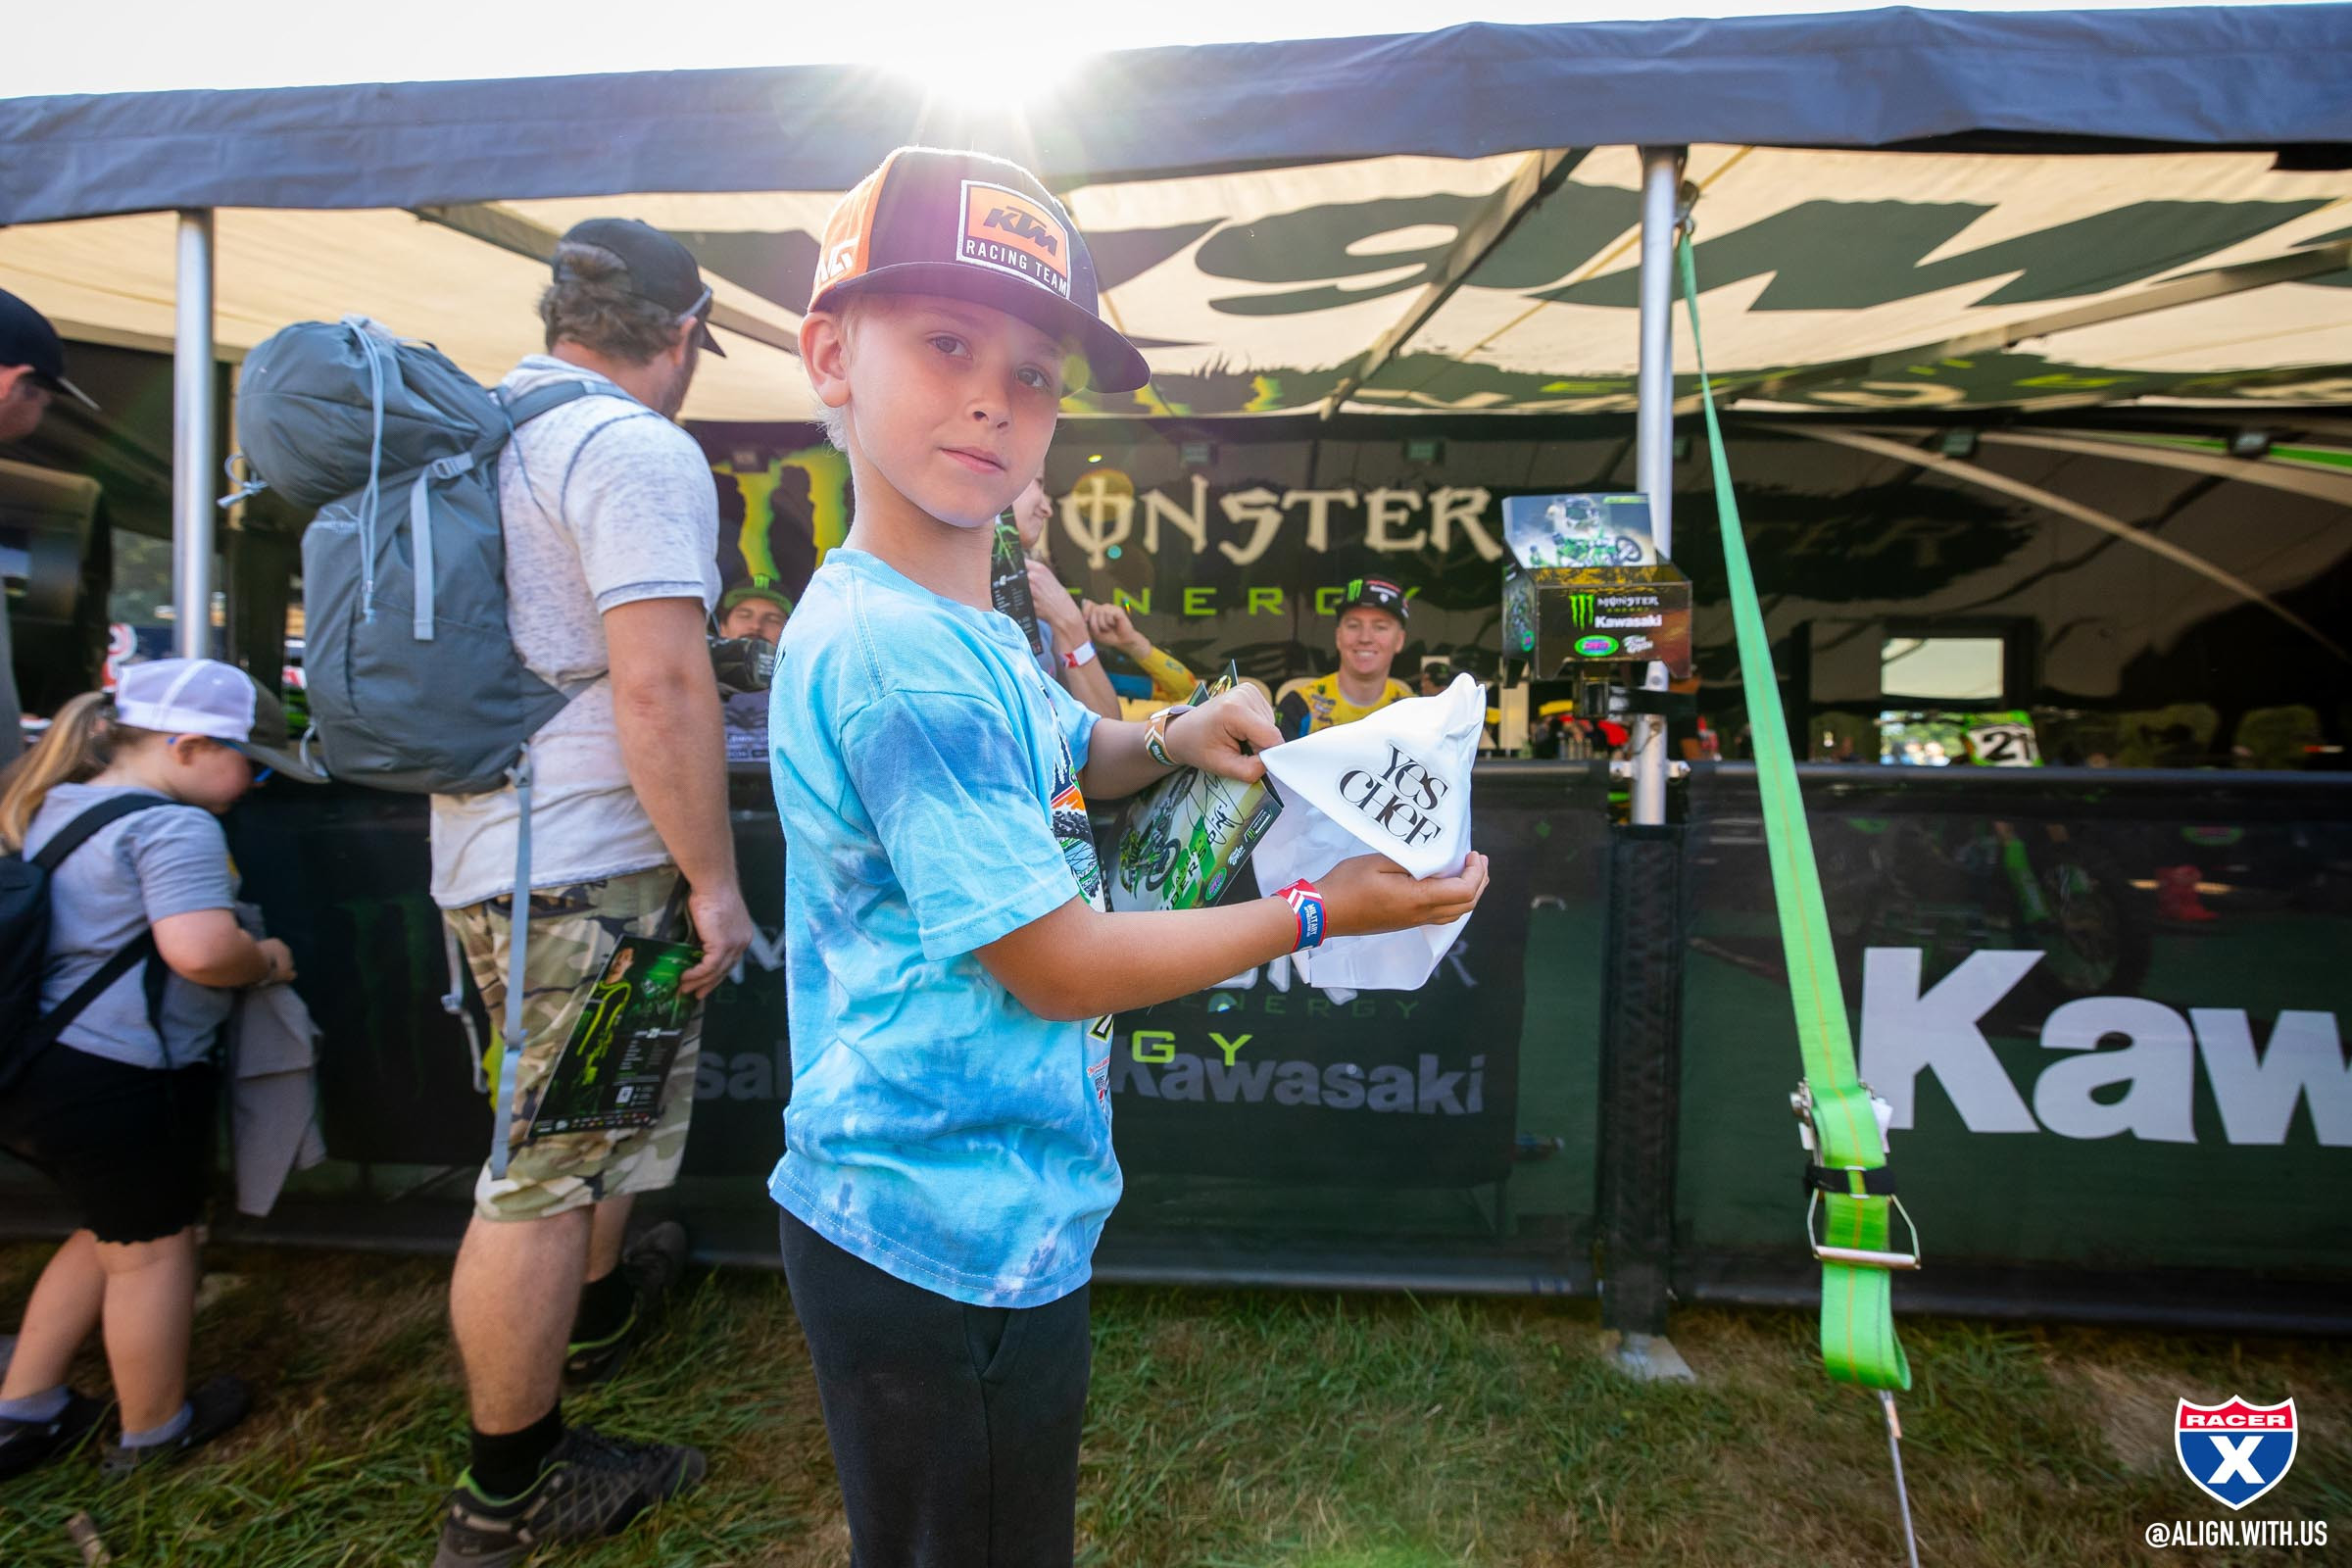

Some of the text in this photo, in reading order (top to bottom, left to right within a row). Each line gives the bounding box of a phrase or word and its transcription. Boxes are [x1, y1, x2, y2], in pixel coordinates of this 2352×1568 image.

[983, 205, 1058, 258] KTM
[965, 239, 1068, 296] RACING TEAM
[1035, 472, 1503, 567] ONSTER
[1066, 585, 1421, 616] NERG
[1594, 614, 1663, 628] Kawasaki
[1983, 731, 2032, 761] 21
